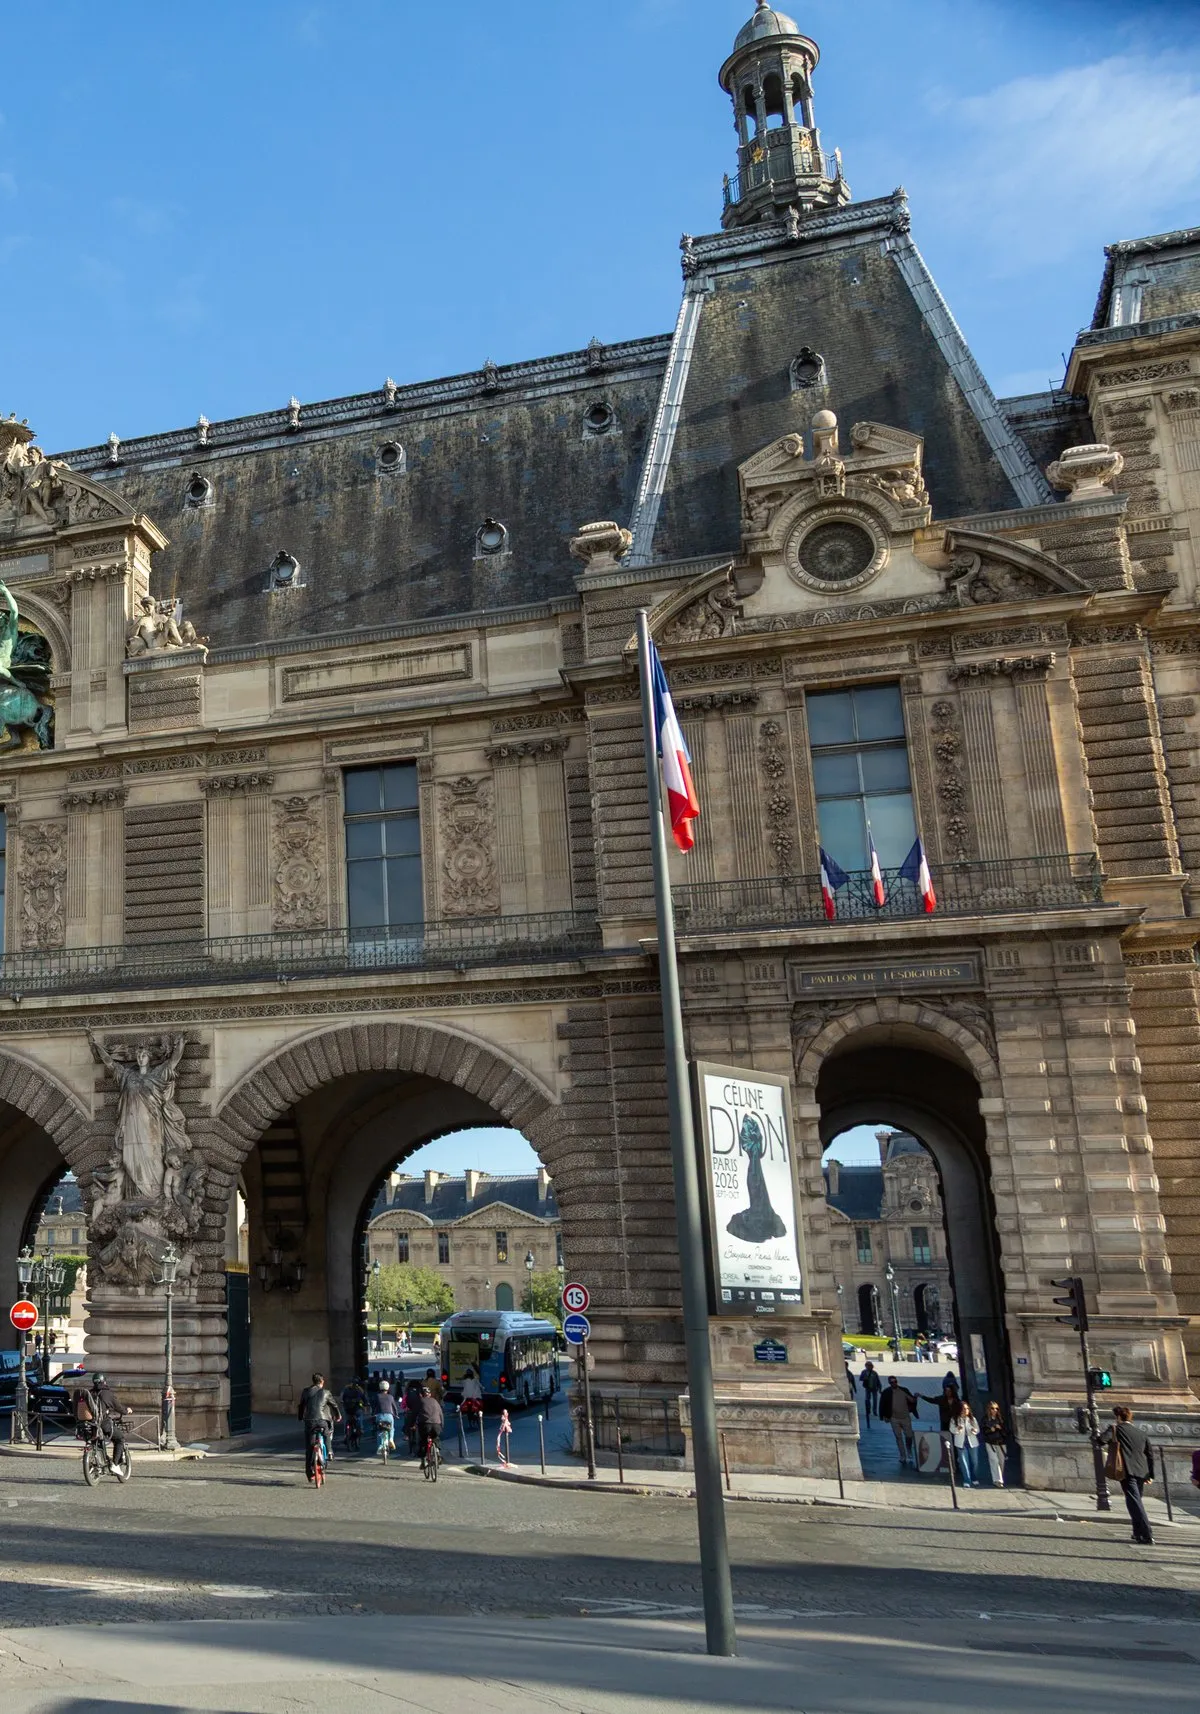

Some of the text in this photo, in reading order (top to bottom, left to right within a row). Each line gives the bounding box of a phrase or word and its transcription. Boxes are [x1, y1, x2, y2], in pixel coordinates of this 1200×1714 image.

[811, 973, 857, 984] PAVILLON
[863, 973, 876, 981] DE
[723, 1081, 764, 1110] CÉLINE
[709, 1105, 787, 1163] DION
[712, 1157, 738, 1172] PARIS
[714, 1172, 739, 1190] 2026
[569, 1291, 583, 1305] 15
